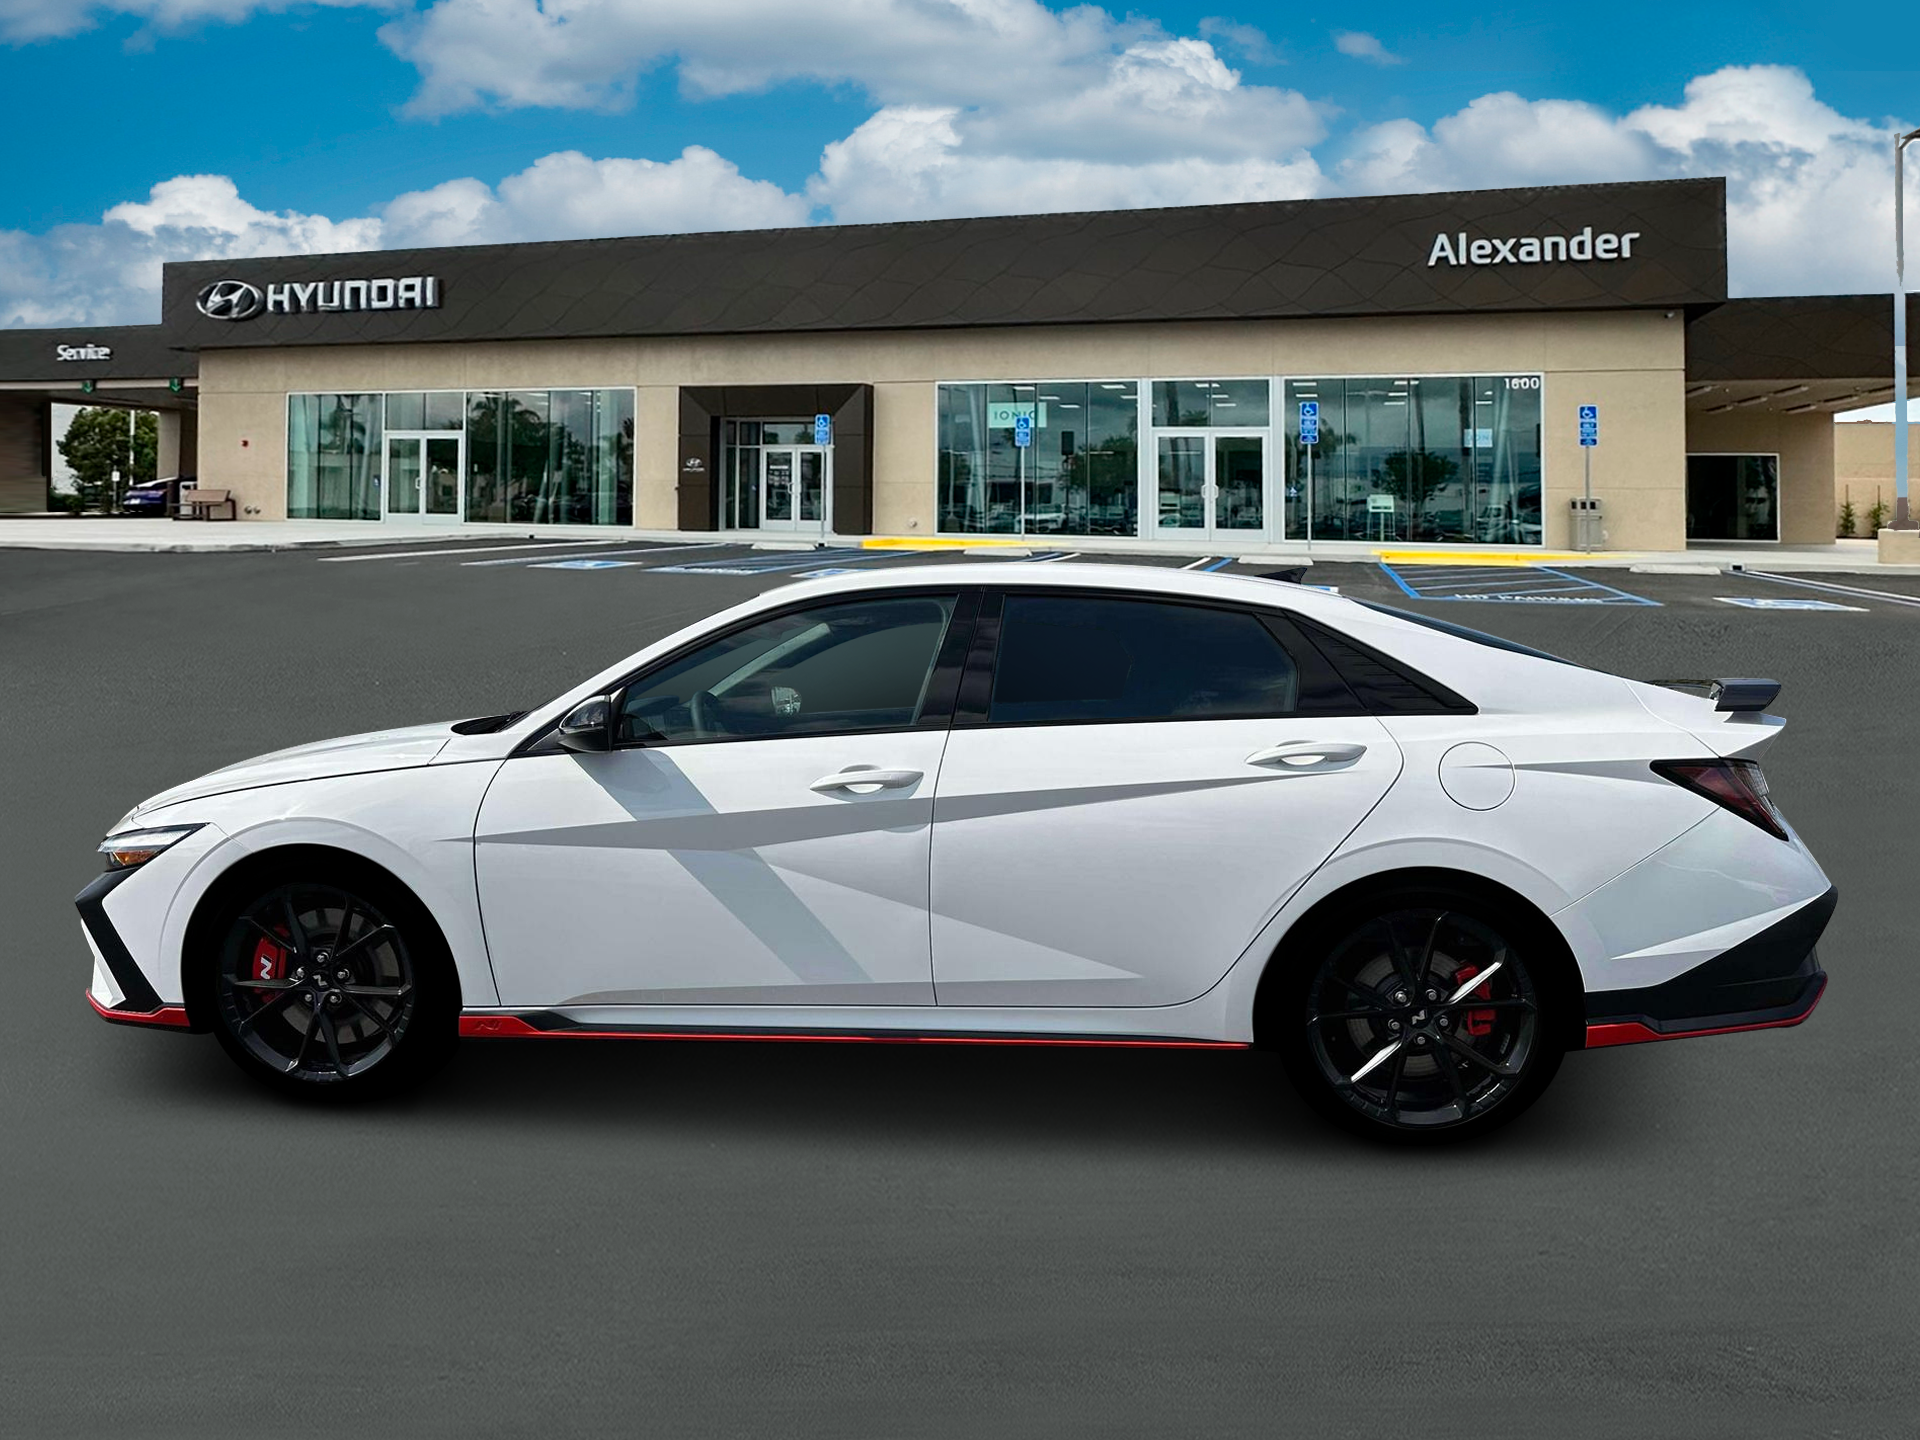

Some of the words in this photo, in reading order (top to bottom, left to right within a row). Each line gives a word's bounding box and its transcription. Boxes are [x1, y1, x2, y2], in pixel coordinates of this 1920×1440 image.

[1428, 227, 1640, 266] Alexander
[266, 277, 438, 313] HYUNDAI
[57, 344, 110, 360] Service
[1504, 377, 1539, 389] 1600
